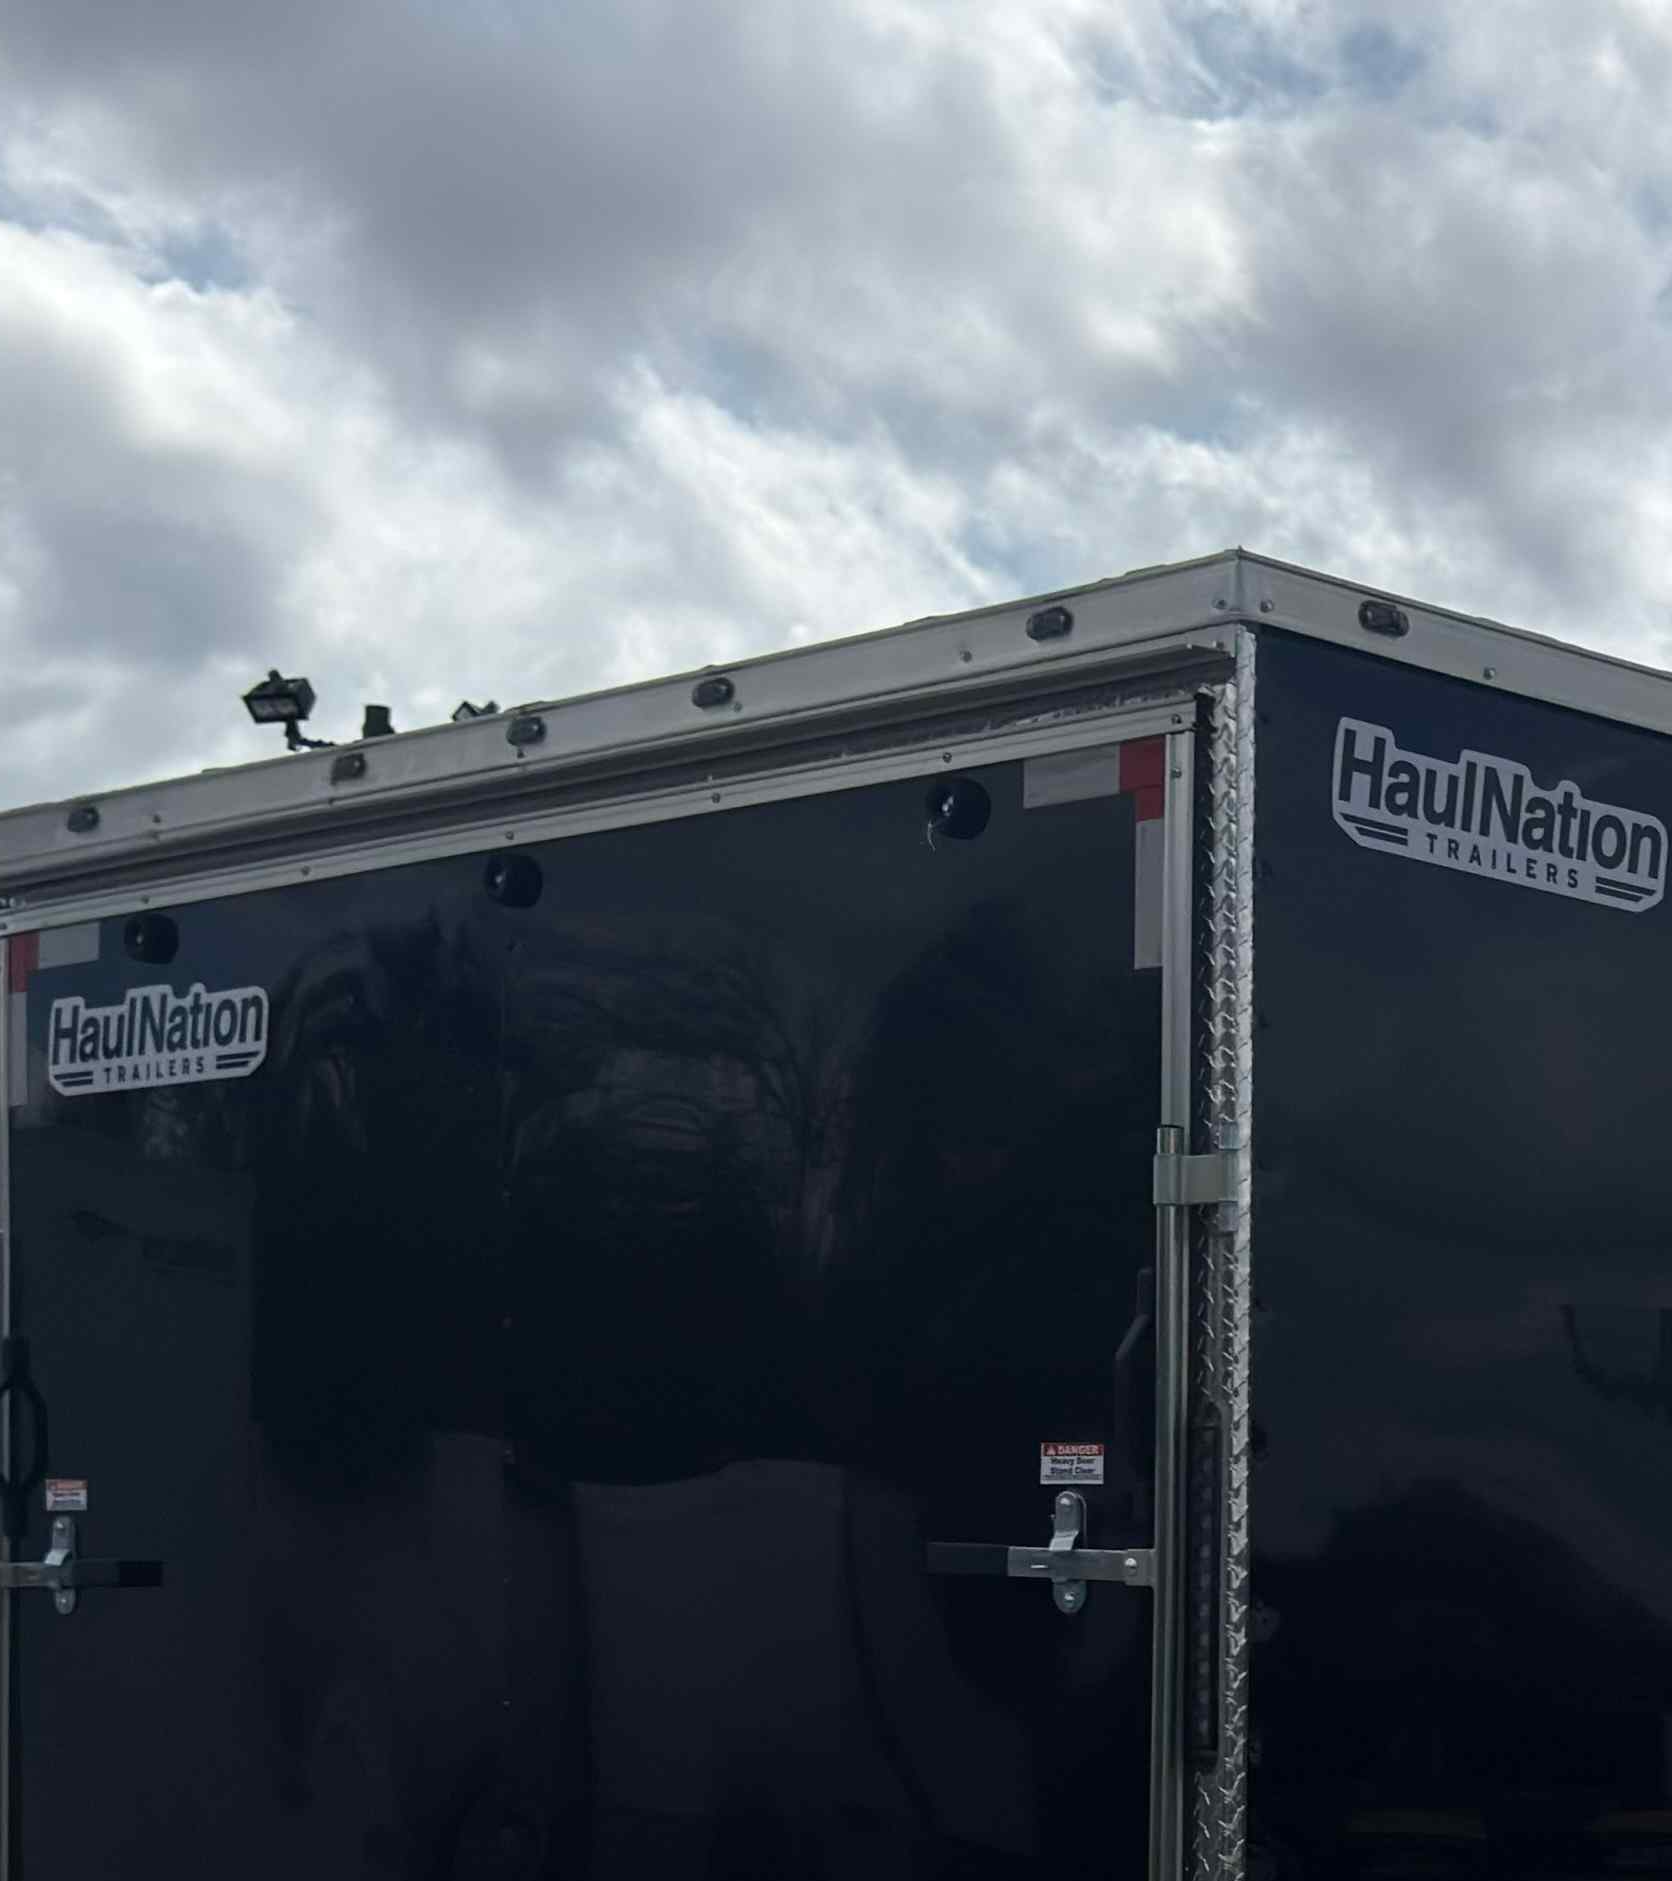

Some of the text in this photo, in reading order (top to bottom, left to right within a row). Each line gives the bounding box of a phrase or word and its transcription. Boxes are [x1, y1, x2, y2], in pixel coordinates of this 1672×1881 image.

[1337, 727, 1661, 880] HaulNation
[1424, 832, 1579, 889] TRAILERS
[51, 991, 264, 1066] HaulNation
[104, 1055, 206, 1085] TRAILERS
